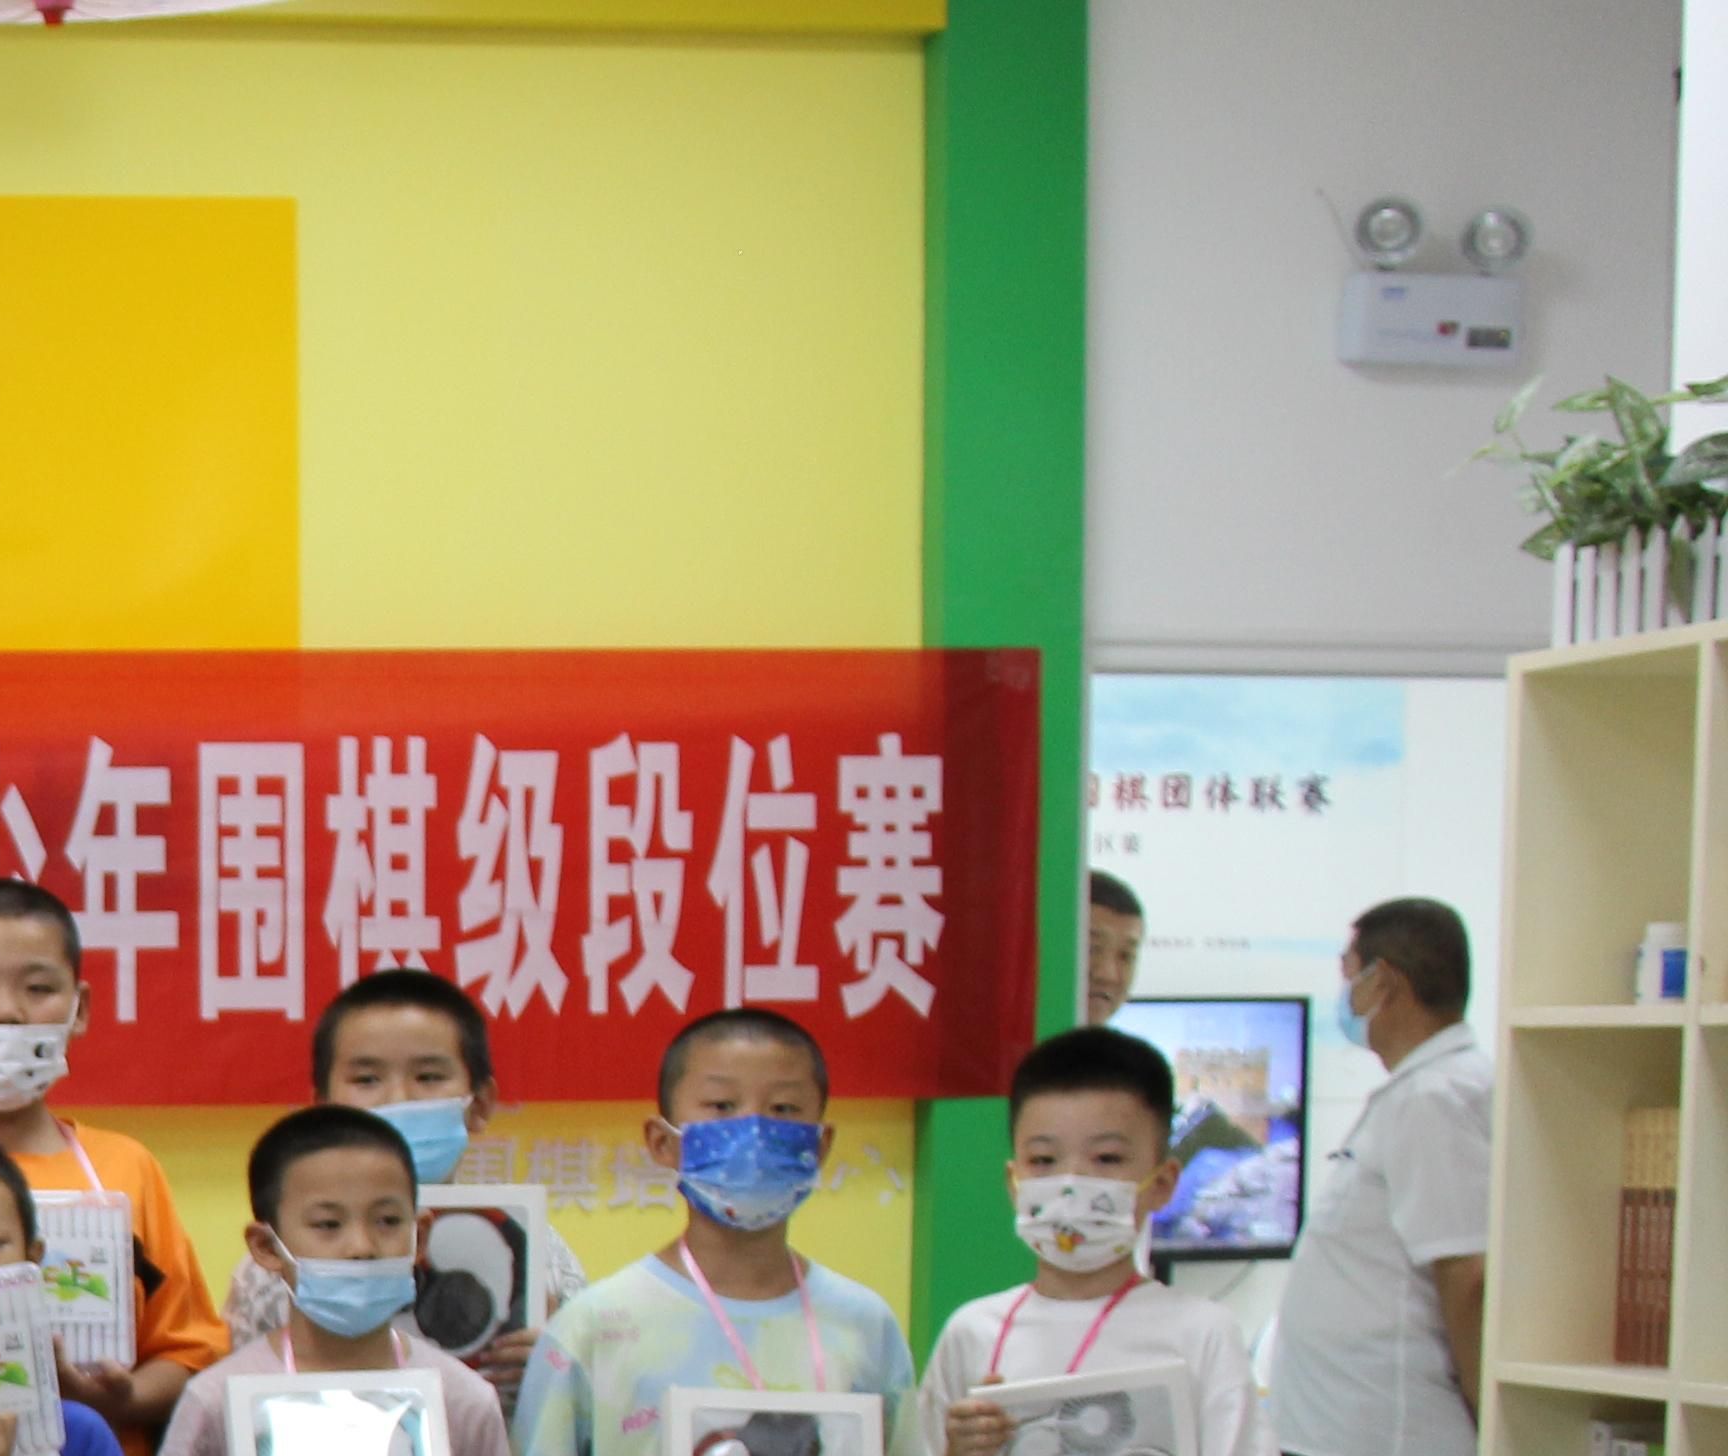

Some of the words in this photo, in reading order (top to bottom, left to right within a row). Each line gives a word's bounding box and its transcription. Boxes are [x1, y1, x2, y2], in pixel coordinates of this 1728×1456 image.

[1088, 772, 1332, 814] 棋团体联赛
